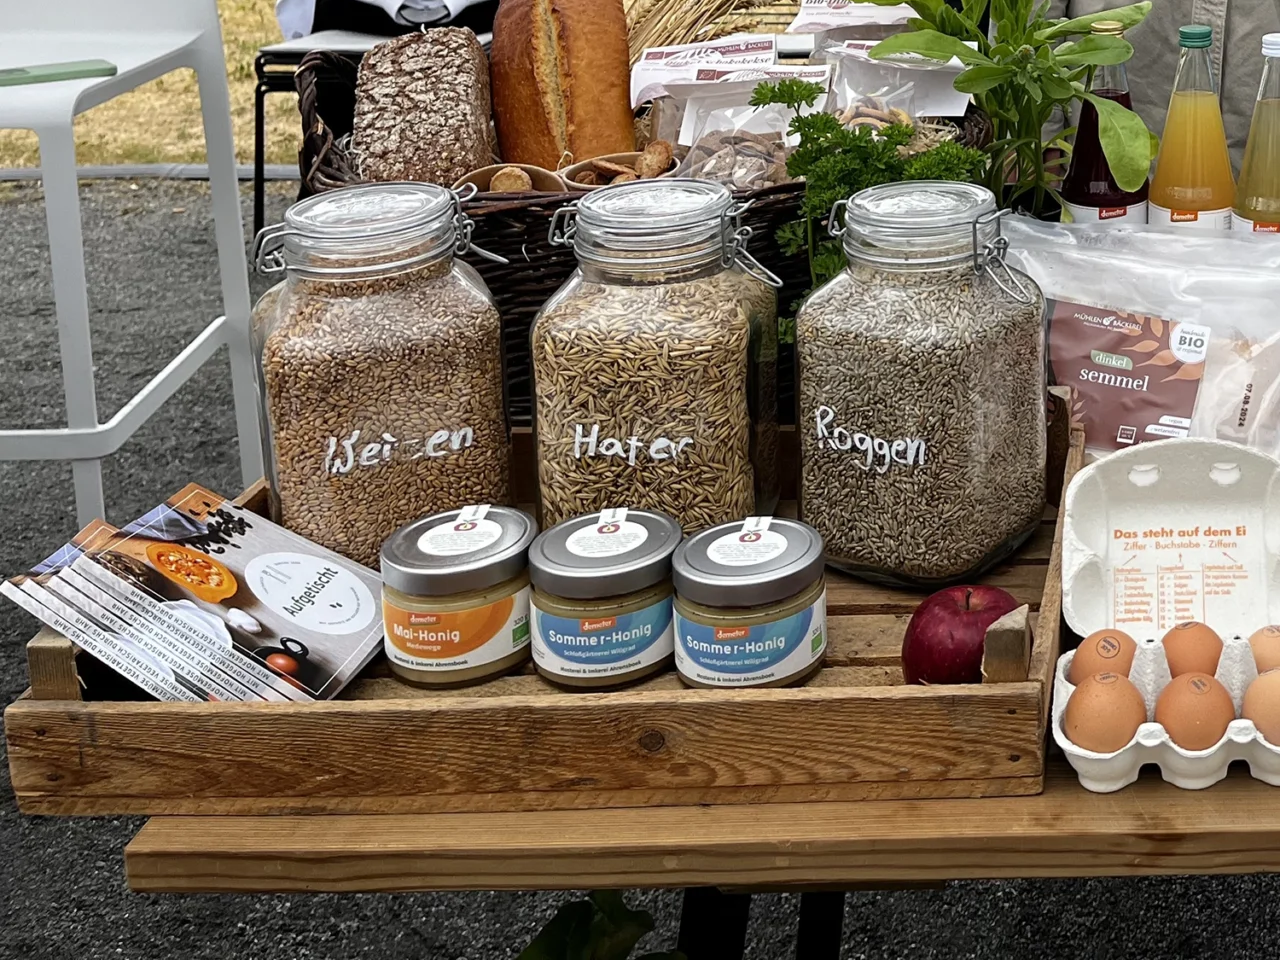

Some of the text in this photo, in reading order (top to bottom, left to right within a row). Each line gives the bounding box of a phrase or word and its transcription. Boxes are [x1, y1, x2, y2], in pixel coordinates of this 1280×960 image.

[1100, 208, 1126, 219] demeter
[1172, 211, 1196, 221] demeter
[1254, 224, 1278, 233] demeter
[1074, 313, 1103, 324] MÜHLEN
[1112, 320, 1142, 330] BÄCKEREI
[1178, 335, 1205, 349] BIO
[1095, 354, 1128, 368] dinkel
[1079, 368, 1150, 392] semmel
[1237, 383, 1253, 428] 07.08.2024
[574, 423, 695, 466] Hafer
[815, 404, 926, 474] Roggen
[325, 426, 475, 474] Weien
[1113, 525, 1247, 540] Das steht auf dem Ei
[1123, 540, 1238, 552] Ziffer Buchstabe Ziffern
[282, 566, 339, 617] Aufgetischt
[410, 615, 437, 625] demeter
[582, 620, 612, 631] demeter
[130, 590, 271, 681] MIT HOFGEMÜSE VEGETARISCH DURCHS JAHR
[393, 623, 461, 643] Mai-Honig
[548, 623, 652, 646] Sommer-Honig
[716, 629, 746, 639] demeter
[686, 635, 786, 655] Sommer-Honig
[743, 672, 775, 683] Ahrensboek
